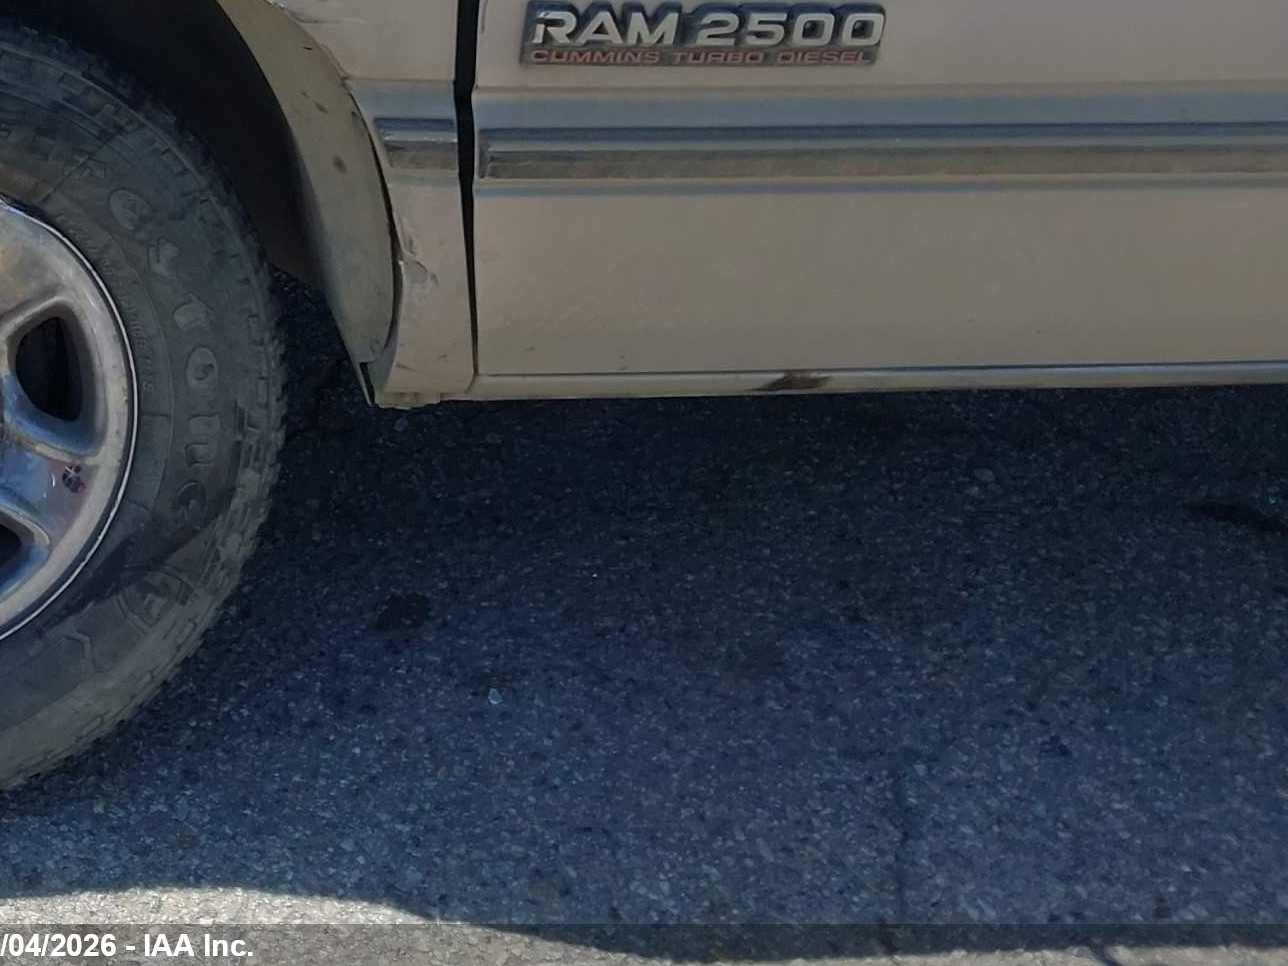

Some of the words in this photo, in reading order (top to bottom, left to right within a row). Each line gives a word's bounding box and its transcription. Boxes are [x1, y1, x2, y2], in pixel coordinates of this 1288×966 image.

[530, 6, 681, 48] RAM
[693, 6, 887, 48] 2500
[528, 49, 661, 65] CUMMINS
[671, 49, 765, 65] TURBO
[776, 49, 875, 65] DIESEL
